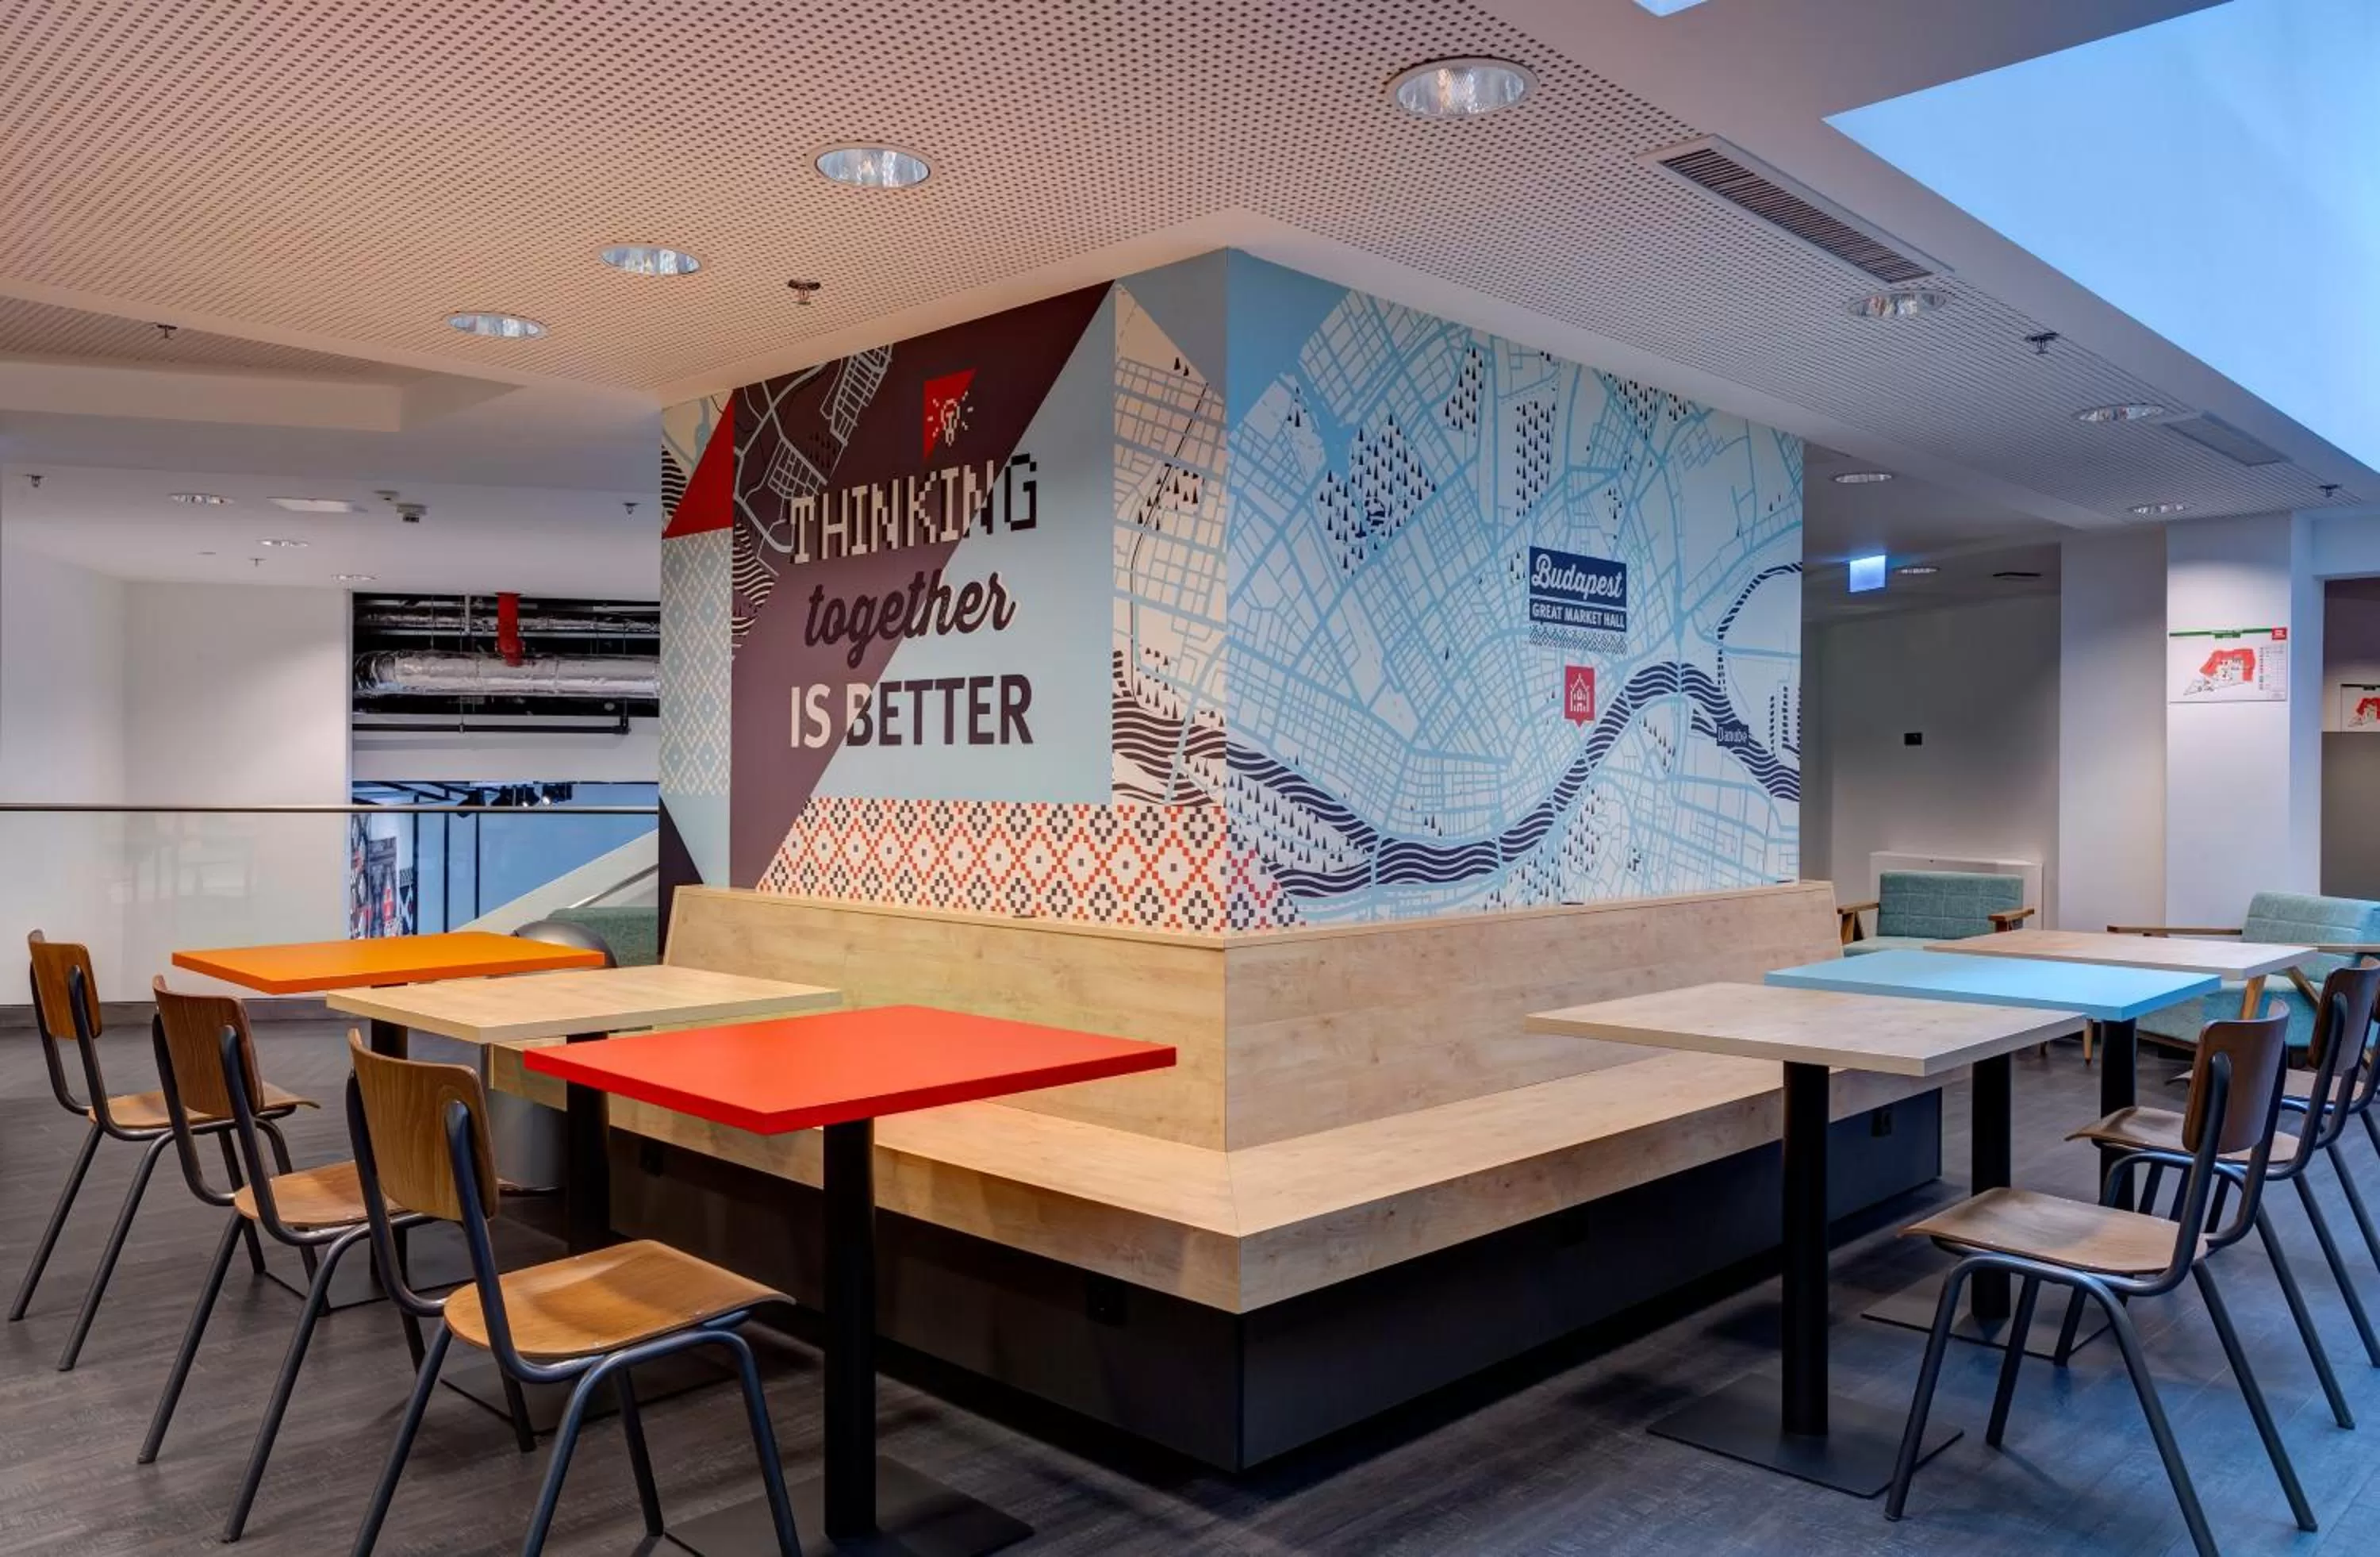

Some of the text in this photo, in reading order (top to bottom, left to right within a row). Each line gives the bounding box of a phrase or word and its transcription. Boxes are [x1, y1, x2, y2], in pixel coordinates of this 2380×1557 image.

[791, 453, 1036, 564] THINKING
[1531, 554, 1622, 600] Budapest
[804, 568, 1017, 668] together
[1533, 603, 1625, 629] GREAT MARKET HALL
[790, 674, 1034, 748] IS BETTER
